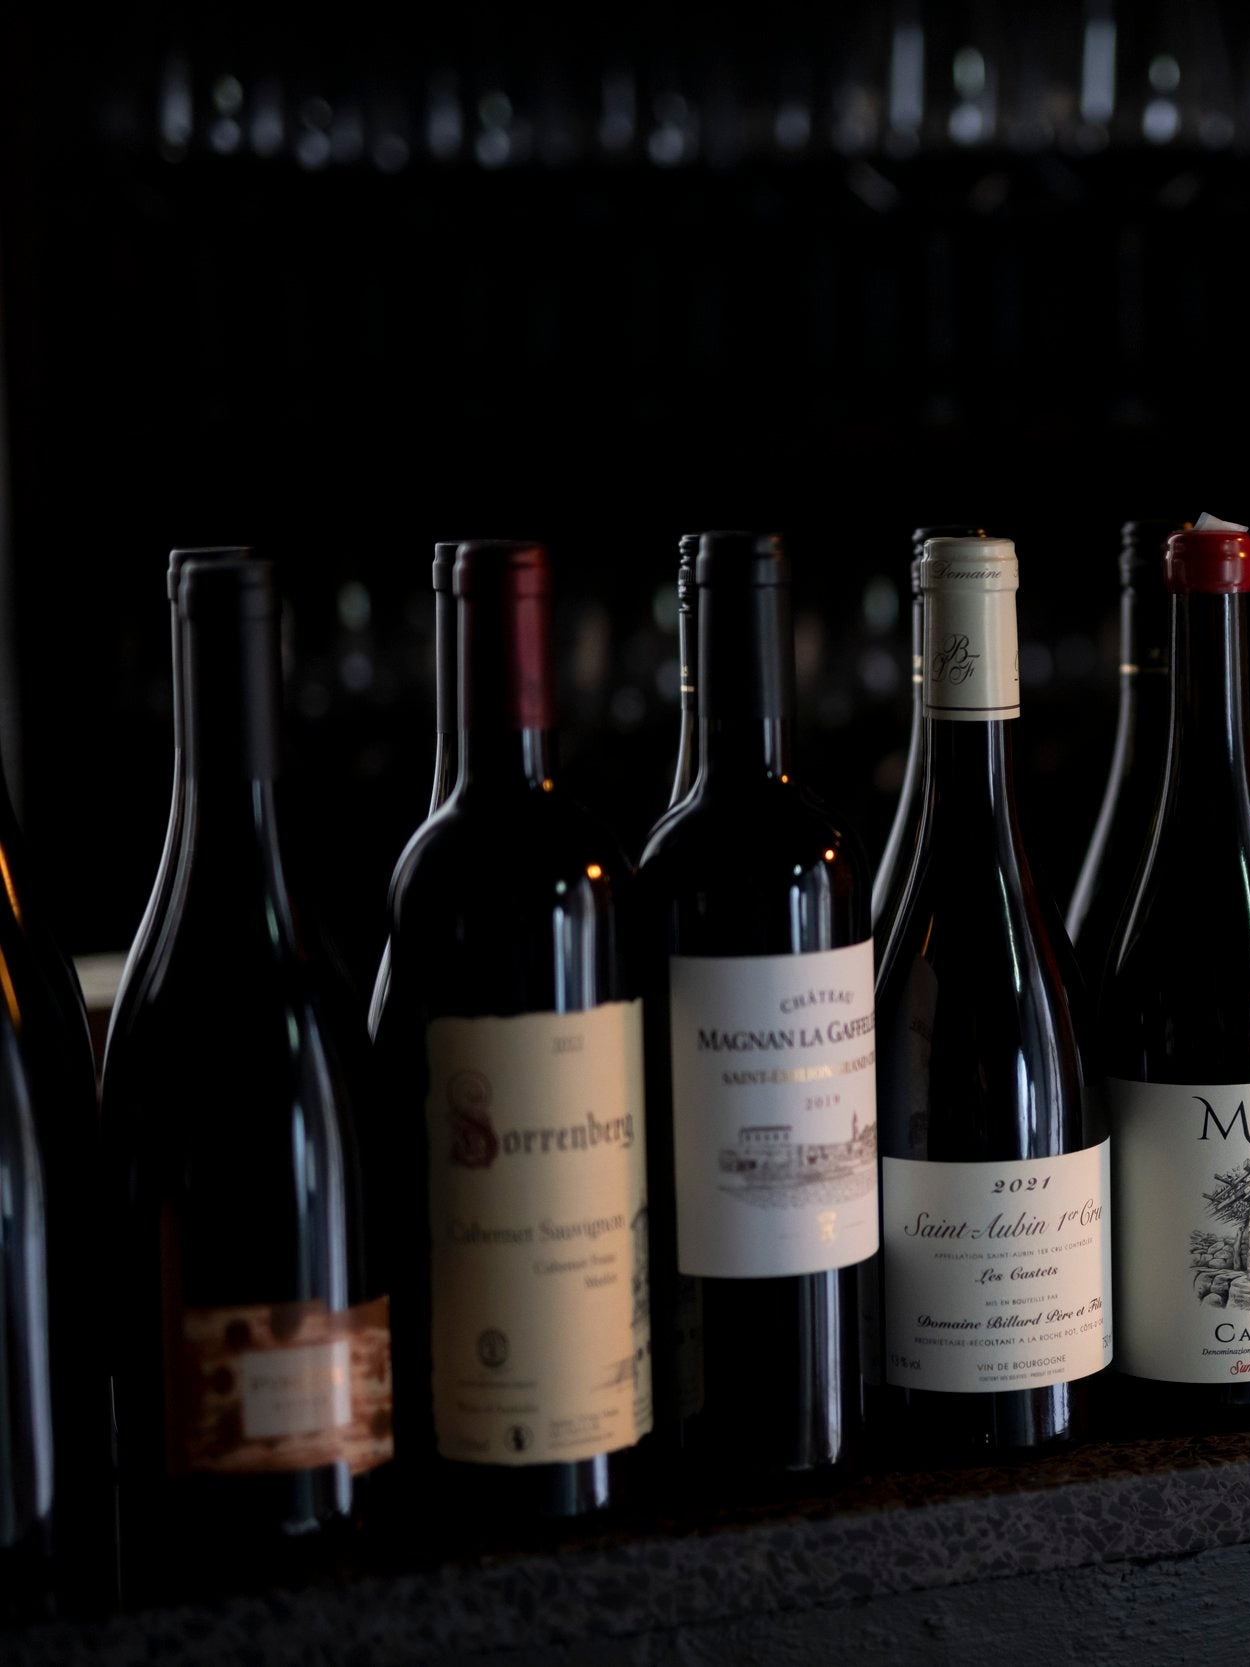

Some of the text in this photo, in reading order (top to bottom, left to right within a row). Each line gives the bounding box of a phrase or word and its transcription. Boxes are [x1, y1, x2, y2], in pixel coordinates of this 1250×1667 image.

[780, 990, 854, 1015] CHÂTEAU
[698, 1028, 794, 1051] MAGNAN
[800, 1028, 822, 1048] LA
[991, 1176, 1051, 1193] 2021
[975, 1266, 1059, 1285] Les Castets
[917, 1314, 982, 1330] Domaine
[987, 1312, 1042, 1330] Billard
[1044, 1309, 1074, 1325] Père
[1076, 1307, 1085, 1317] et
[1039, 1330, 1063, 1341] ROCHE
[977, 1354, 1066, 1372] VIN DE BOURGOGNE
